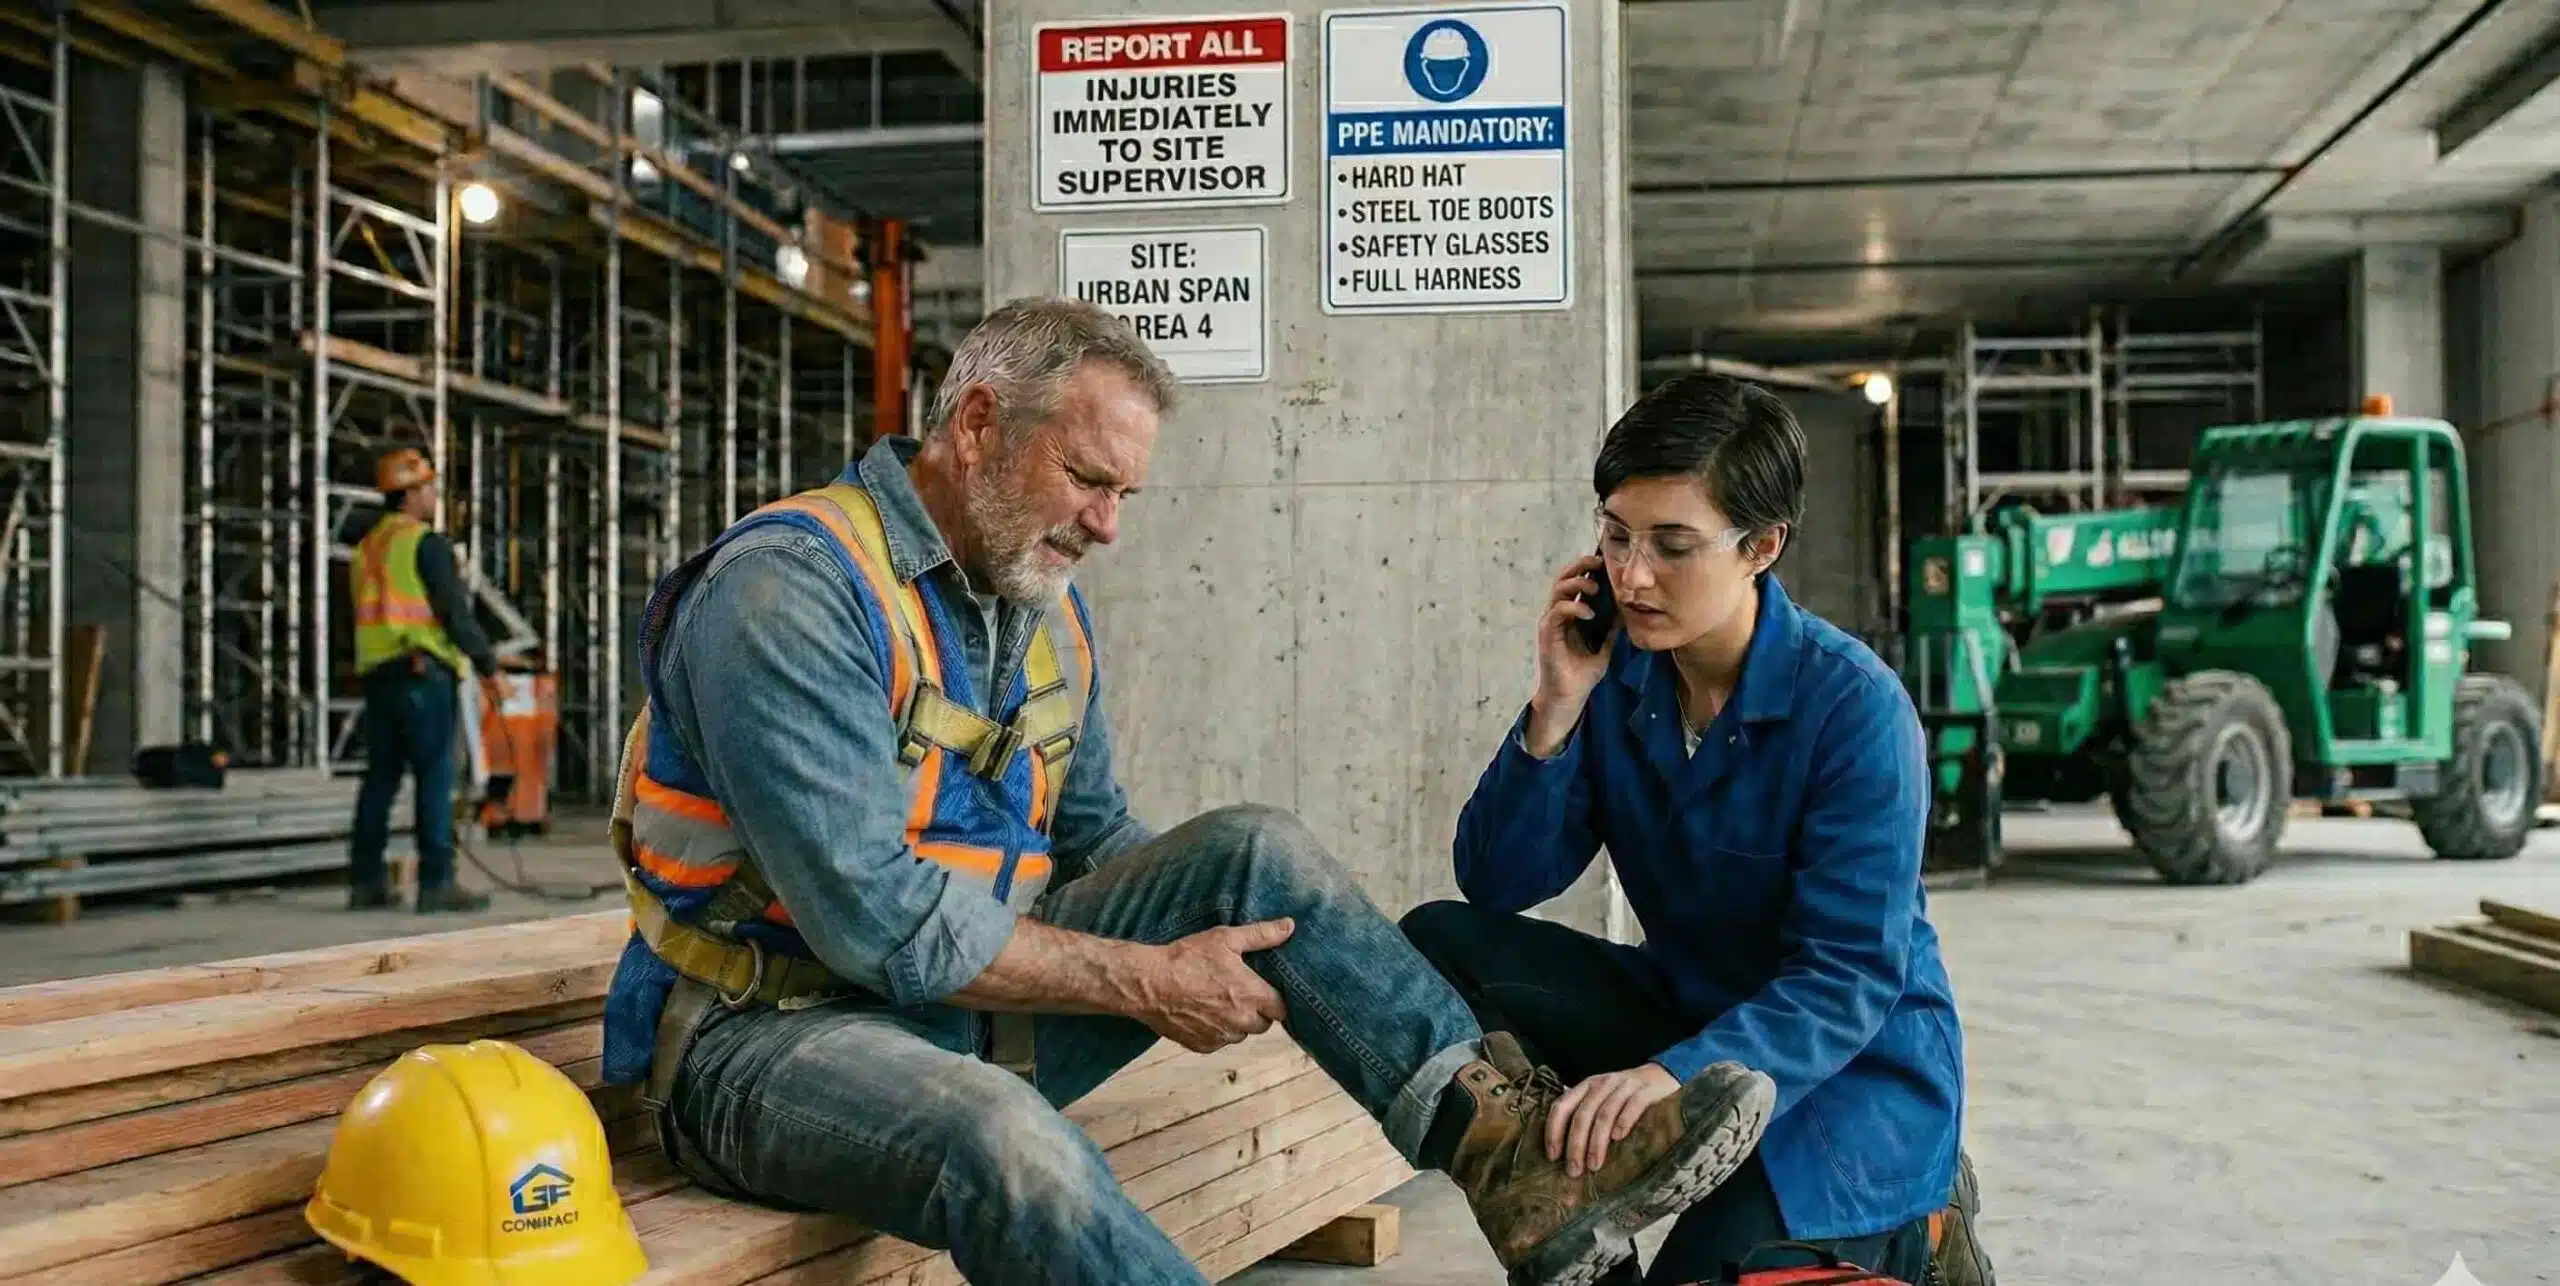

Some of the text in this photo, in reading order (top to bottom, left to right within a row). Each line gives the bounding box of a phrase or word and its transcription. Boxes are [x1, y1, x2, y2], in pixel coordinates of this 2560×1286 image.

[1061, 29, 1263, 63] REPORT ALL
[1086, 73, 1237, 102] INJURIES
[1053, 102, 1272, 134] IMMEDIATELY
[1338, 116, 1554, 148] PPE MANDATORY:
[1099, 135, 1225, 163] TO SITE
[1058, 165, 1266, 195] SUPERVISOR
[1352, 163, 1466, 188] HARD HAT
[1351, 195, 1554, 223] STEEL TOE BOOTS
[1130, 242, 1196, 269] SITE:
[1351, 230, 1550, 258] SAFETY GLASSES
[1078, 276, 1250, 304] URBAN SPAN
[1353, 265, 1521, 292] FULL HARNESS
[1117, 313, 1213, 340] REA 4
